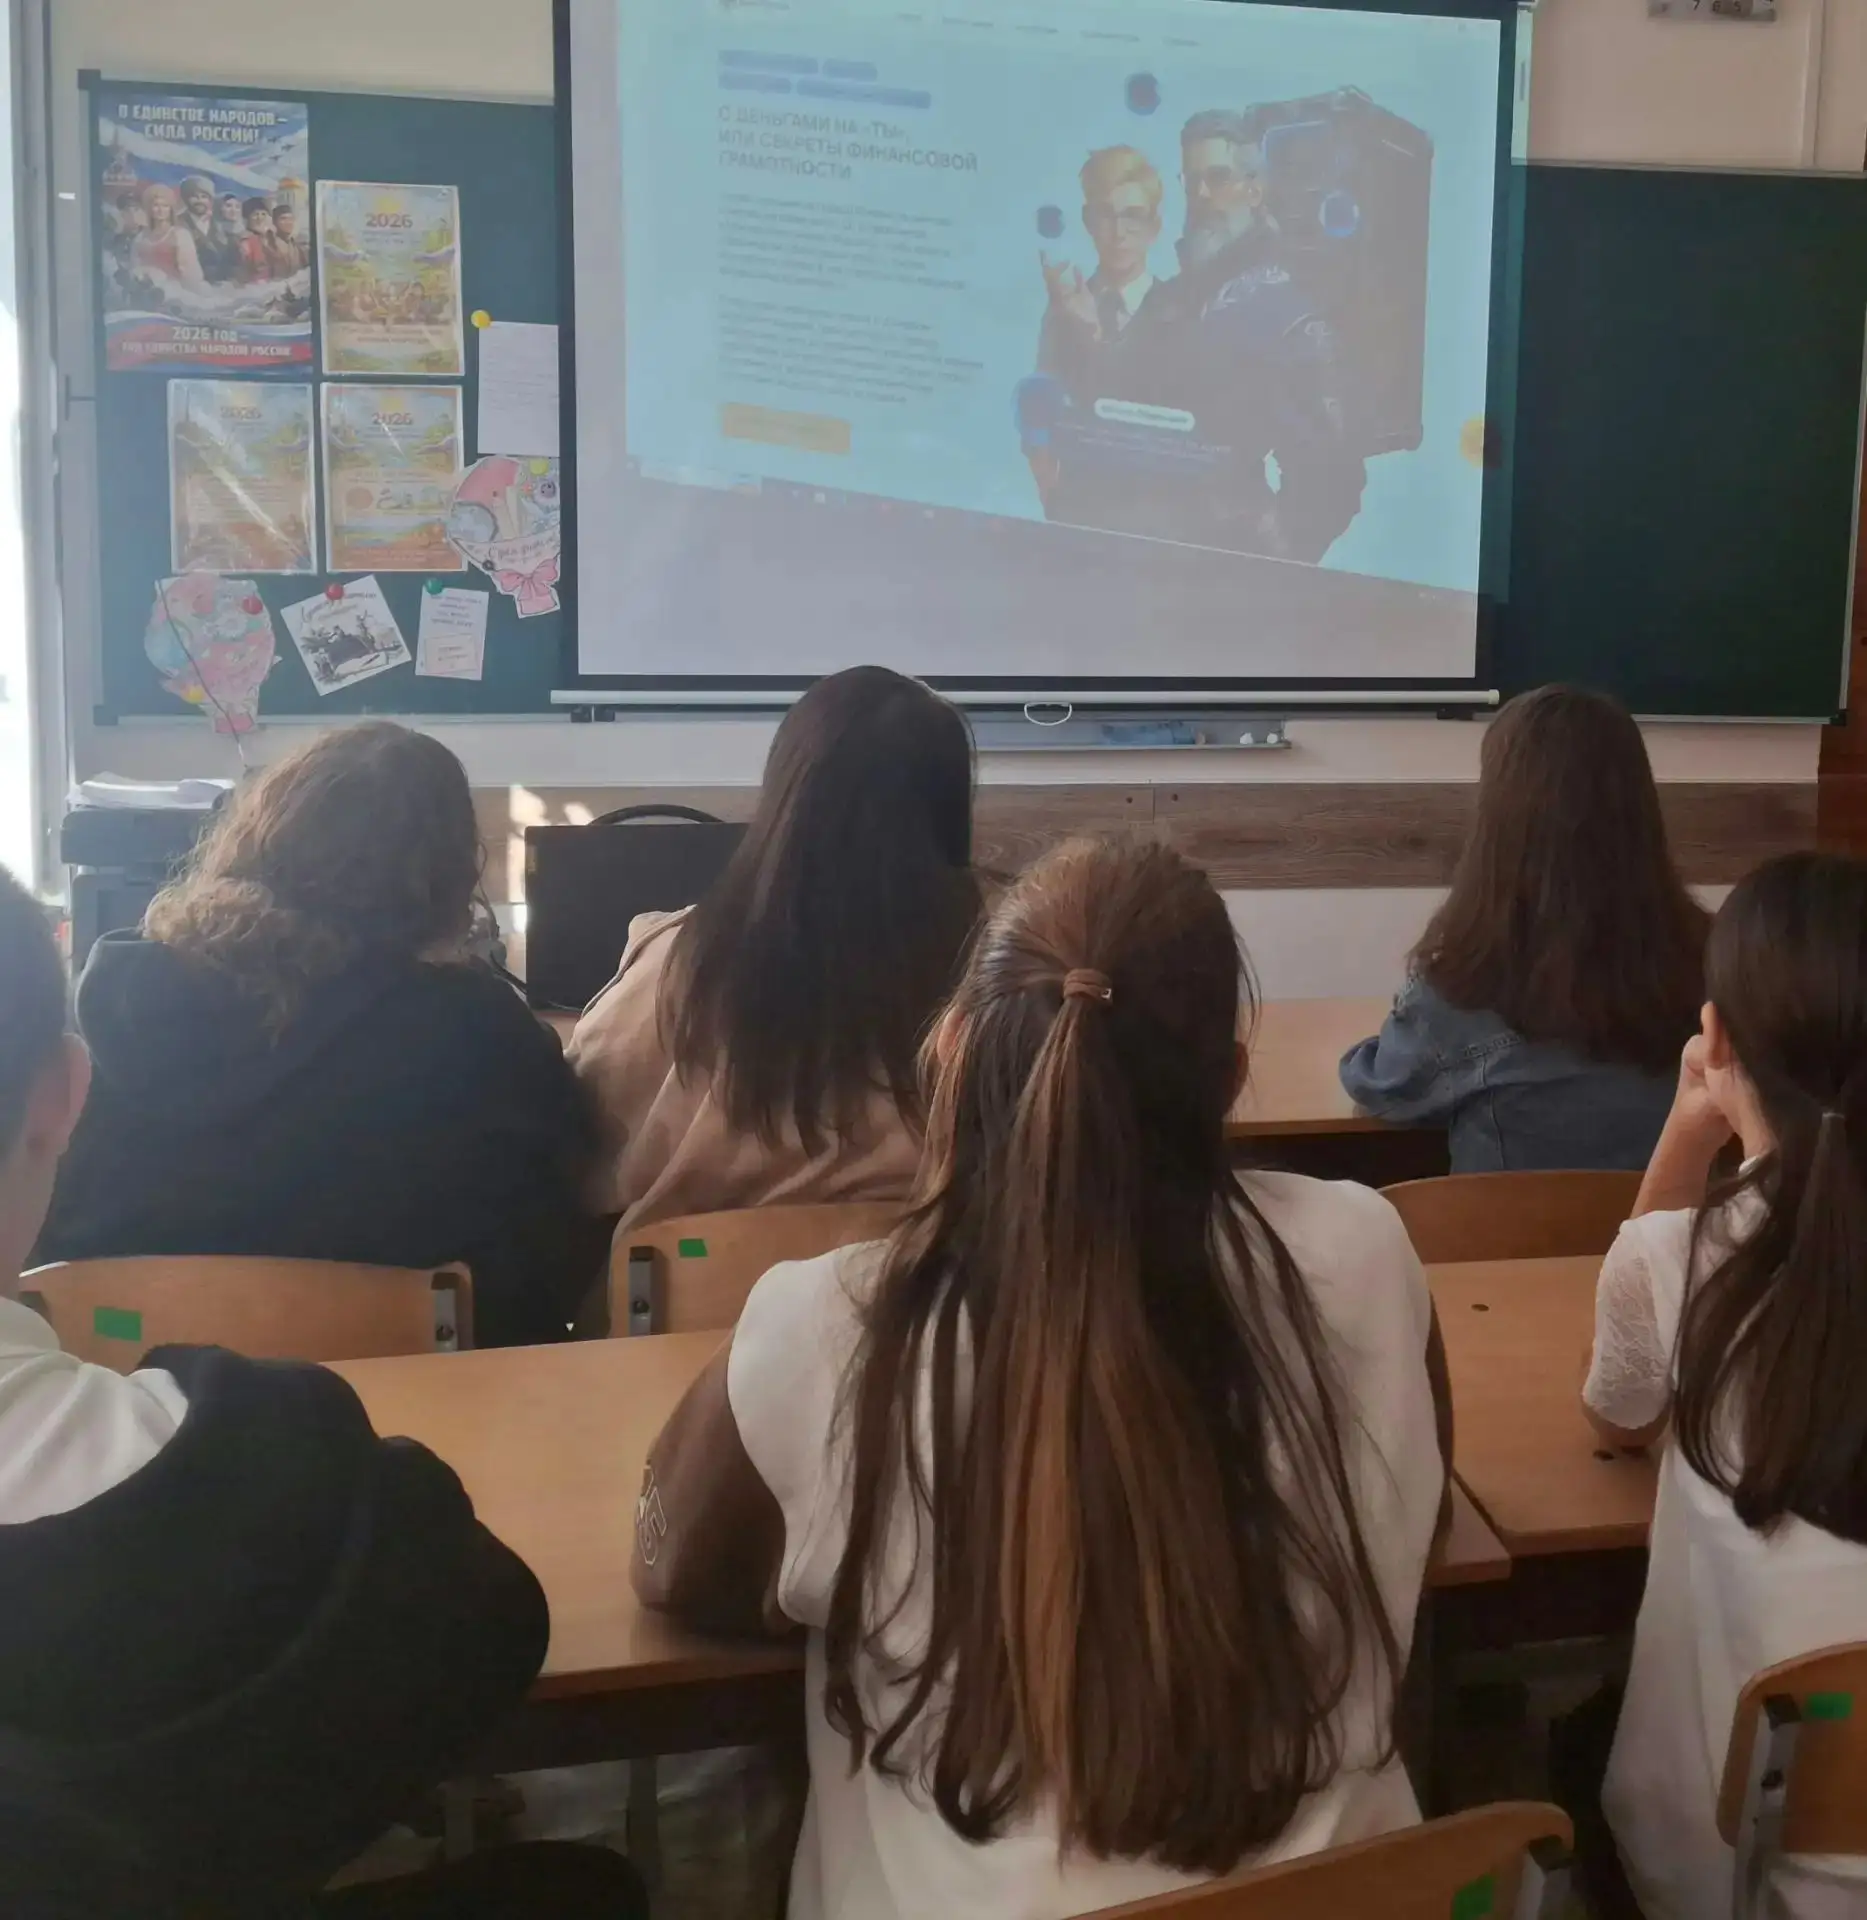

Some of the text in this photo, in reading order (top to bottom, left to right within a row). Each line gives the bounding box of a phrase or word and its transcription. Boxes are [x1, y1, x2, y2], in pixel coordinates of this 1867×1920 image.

[132, 104, 205, 121] ЕДИНСТВЕ
[209, 109, 275, 127] НАРОДОВ
[144, 123, 259, 143] СИЛА РОССИИ!
[718, 129, 979, 172] ИЛИ СЕКРЕТЫ ФИНАНСОВОЙ
[718, 150, 852, 180] ГРАМОТНОСТИ
[365, 212, 413, 228] 2026
[173, 326, 210, 340] 2026
[371, 412, 413, 426] 2026
